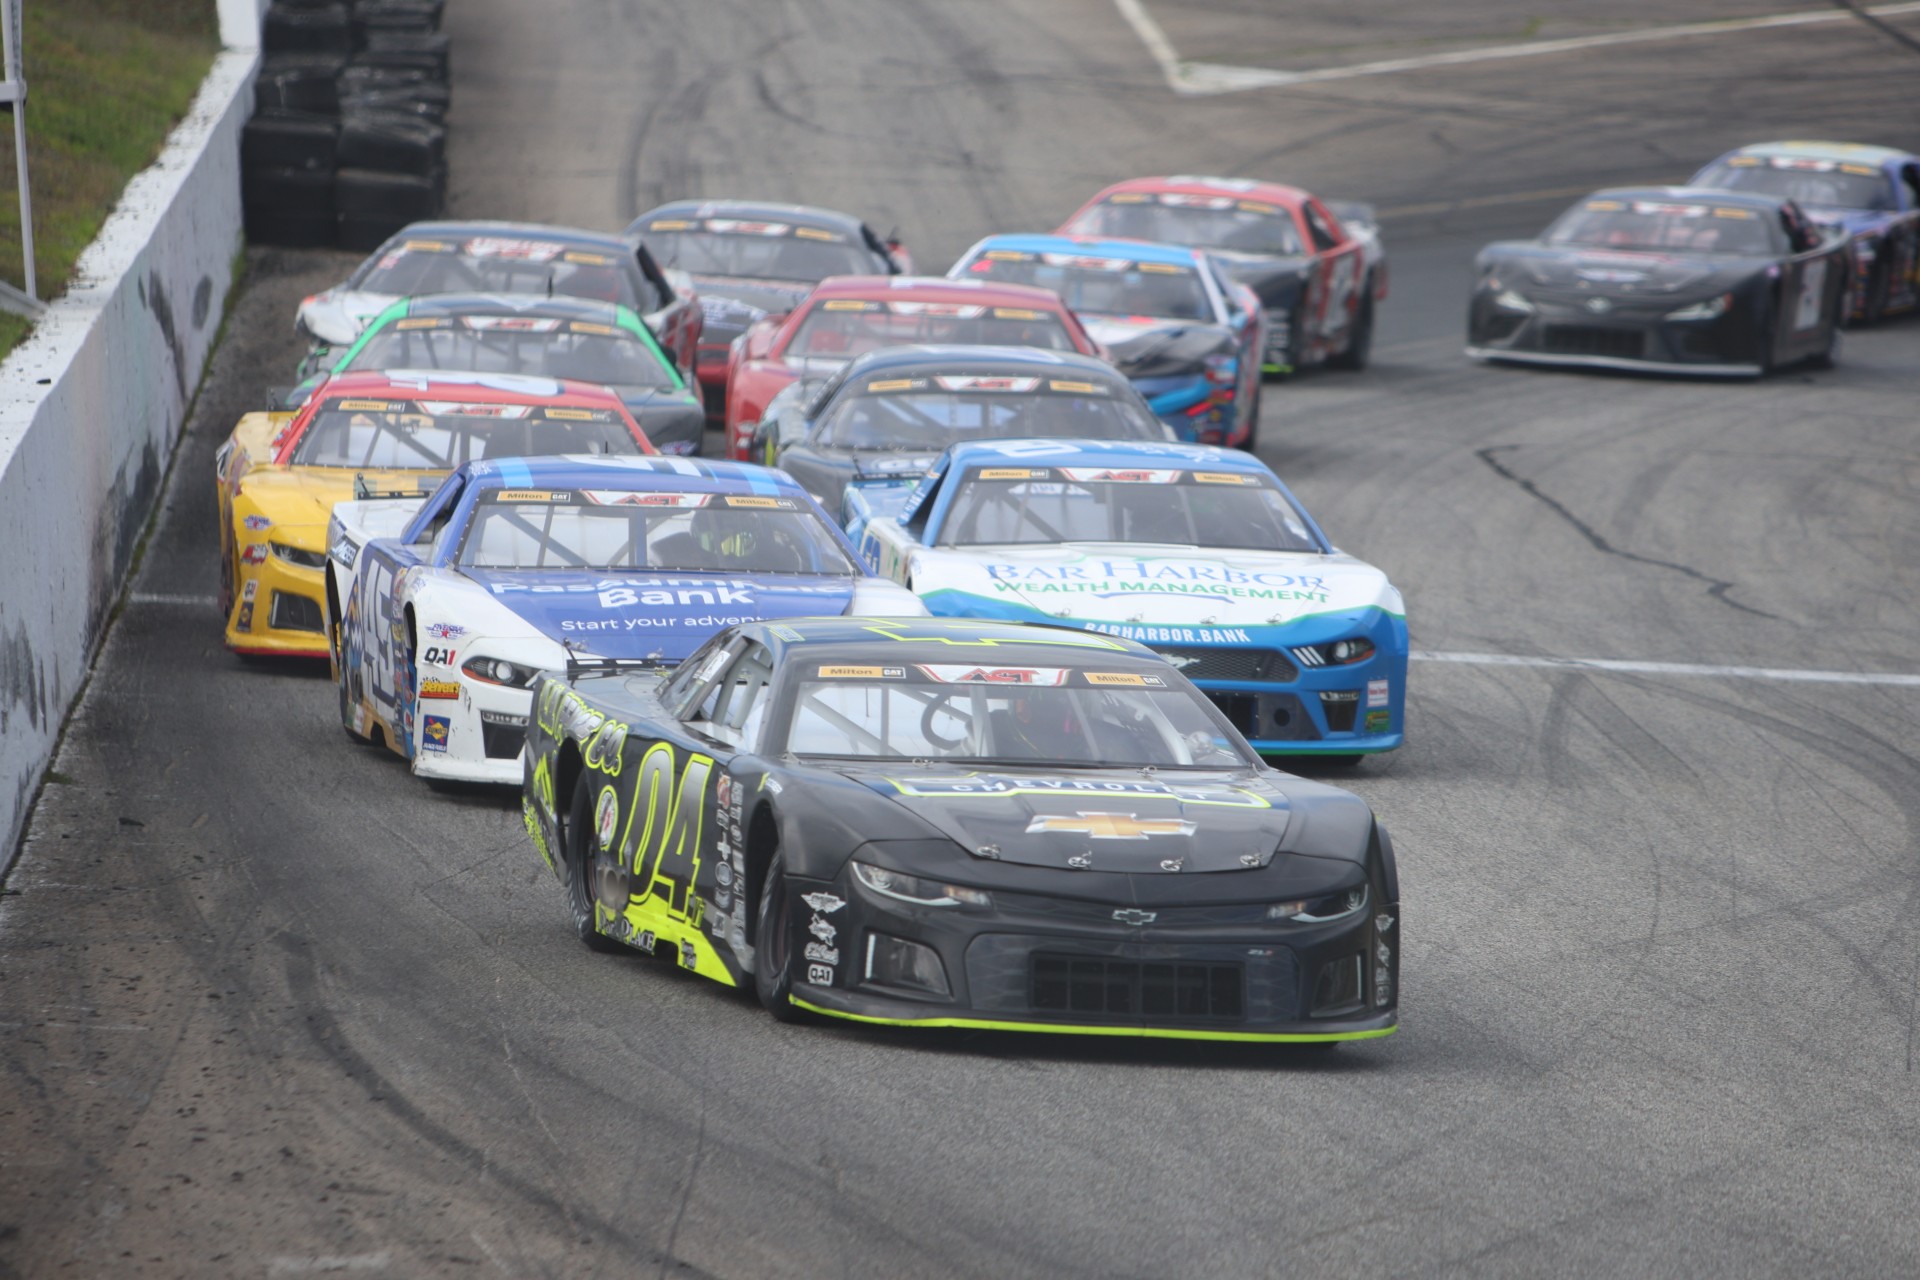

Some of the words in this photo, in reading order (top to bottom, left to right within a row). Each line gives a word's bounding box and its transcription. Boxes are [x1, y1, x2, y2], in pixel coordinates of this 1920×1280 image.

[507, 492, 543, 500] Milton
[552, 493, 568, 501] CAT
[736, 498, 771, 506] Milton
[986, 564, 1090, 579] BAR
[1101, 561, 1330, 591] HARBOR
[597, 586, 754, 608] Bank
[994, 580, 1110, 593] WEALTH
[1119, 581, 1330, 603] MANAGEMENT
[561, 619, 620, 631] Start
[625, 618, 677, 630] your
[1084, 622, 1251, 643] BARHARBOR.BANK
[424, 646, 456, 666] QA1
[830, 668, 873, 676] Milton
[884, 668, 902, 677] CAT
[958, 667, 1040, 684] ACT
[1095, 674, 1136, 684] Milton
[1143, 676, 1161, 686] CAT
[619, 742, 714, 923] 04
[810, 967, 831, 982] QA1
